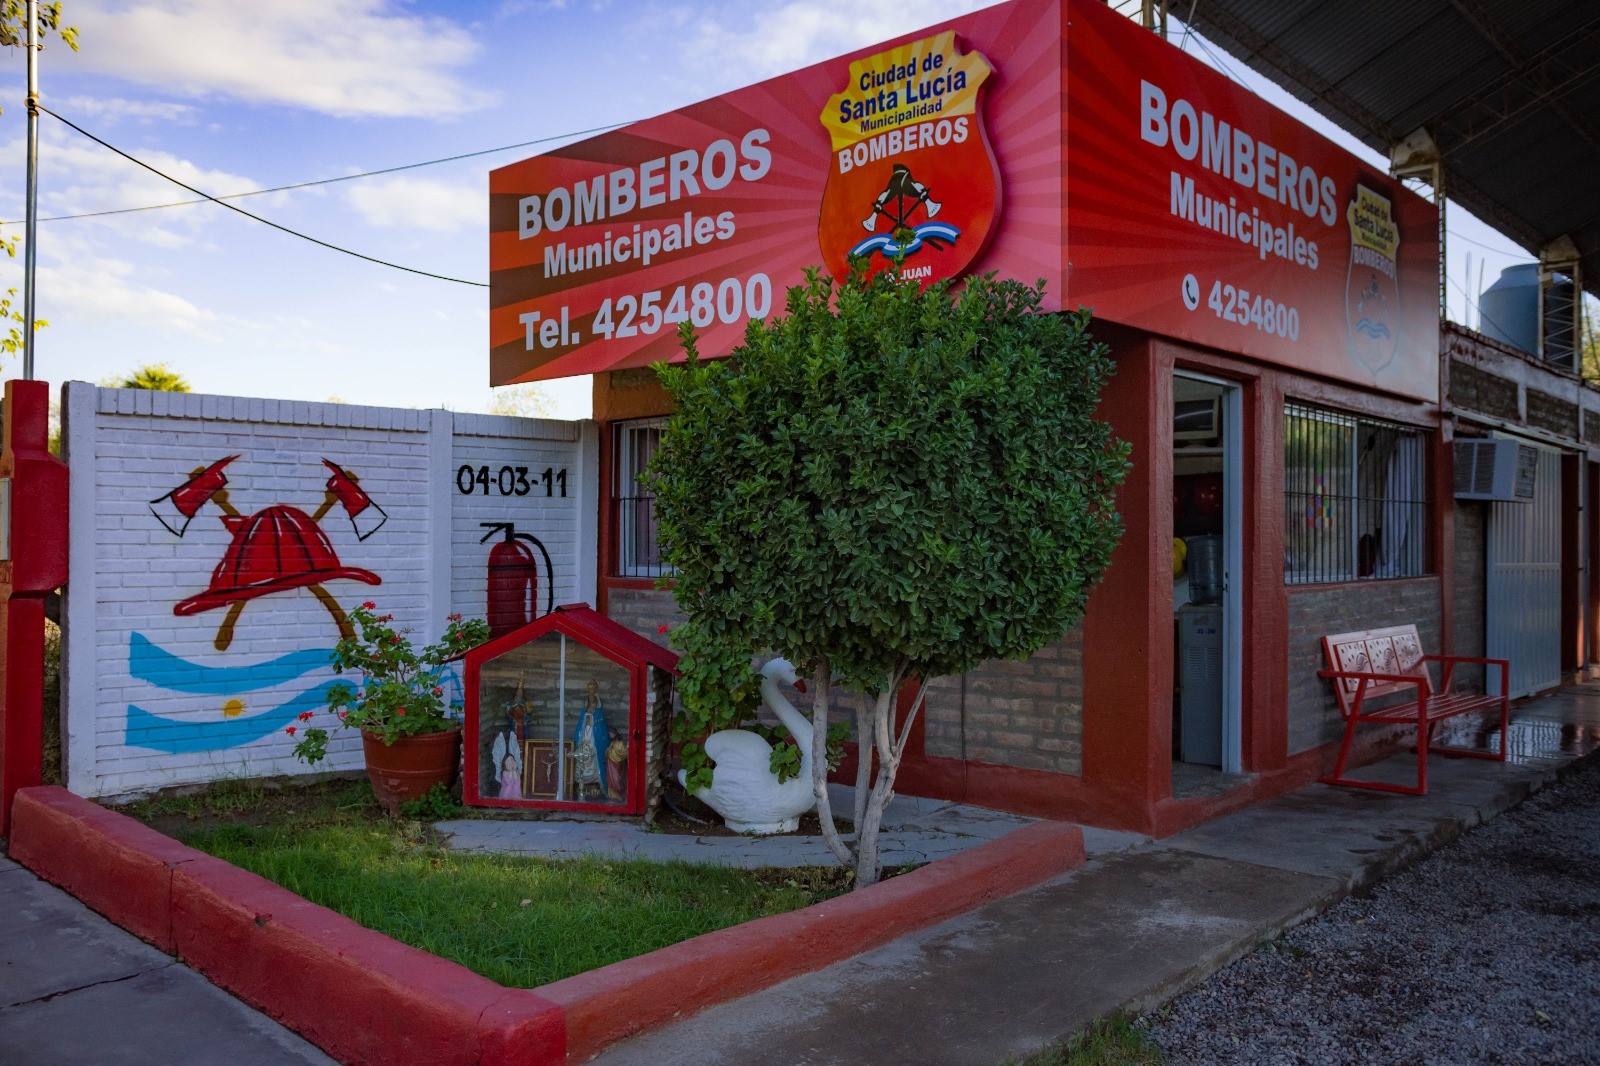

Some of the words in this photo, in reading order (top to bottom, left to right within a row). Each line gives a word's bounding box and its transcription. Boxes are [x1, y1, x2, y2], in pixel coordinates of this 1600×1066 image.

[839, 88, 898, 124] Santa
[906, 66, 967, 104] Lucía
[860, 58, 916, 91] Ciudad
[922, 52, 943, 73] de
[860, 99, 942, 133] Municipalidad
[838, 117, 969, 174] BOMBEROS
[1140, 79, 1337, 227] BOMBEROS
[518, 128, 772, 240] BOMBEROS
[544, 211, 736, 279] Municipales
[1170, 171, 1319, 270] Municipales
[899, 265, 932, 281] JUAN
[1354, 245, 1395, 280] BOMBEROS
[519, 306, 580, 351] Tel.
[592, 273, 772, 340] 4254800
[1208, 280, 1300, 342] 4254800
[456, 464, 567, 498] 04-03-11
